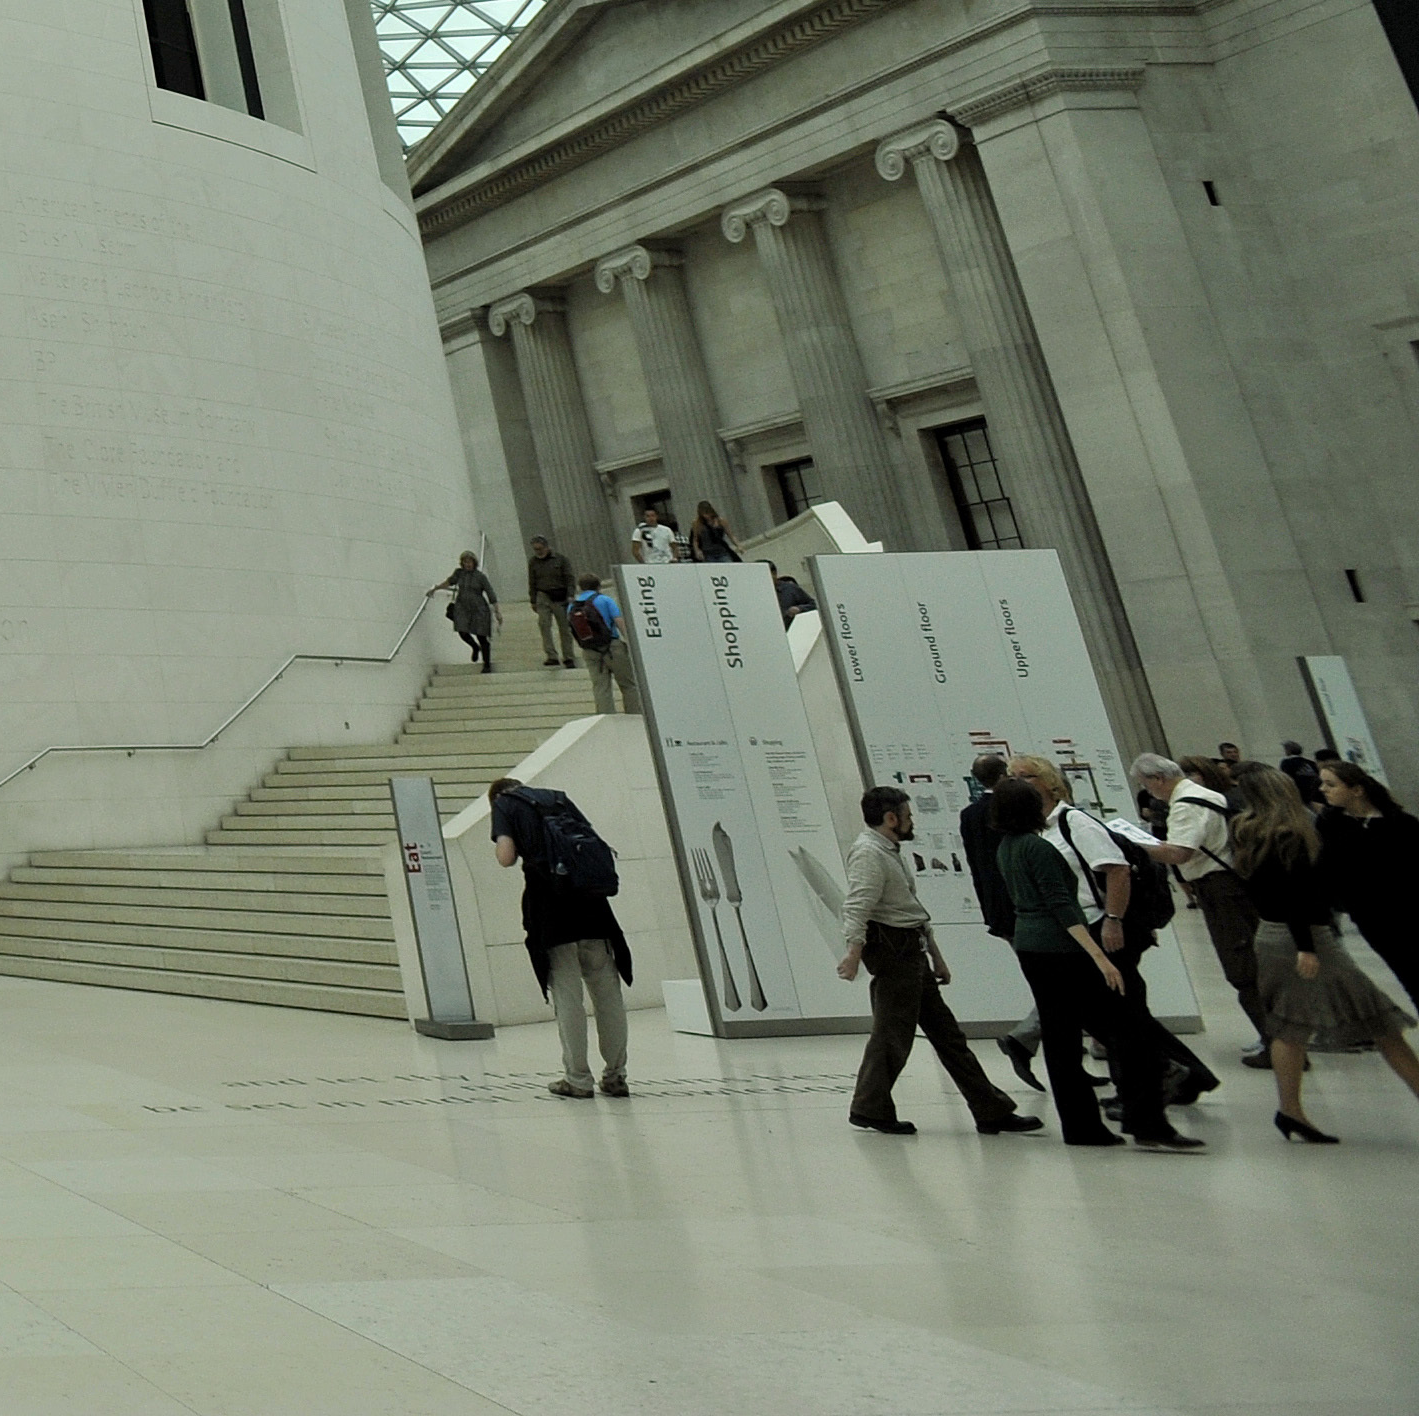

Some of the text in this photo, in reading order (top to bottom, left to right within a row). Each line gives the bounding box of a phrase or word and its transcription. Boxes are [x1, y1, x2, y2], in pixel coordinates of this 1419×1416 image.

[637, 575, 663, 639] Eating
[710, 575, 744, 669] Shopping
[836, 602, 865, 683] Lower floors
[916, 601, 947, 684] Ground floor
[998, 599, 1030, 678] Upper floors
[403, 842, 423, 874] Eat
